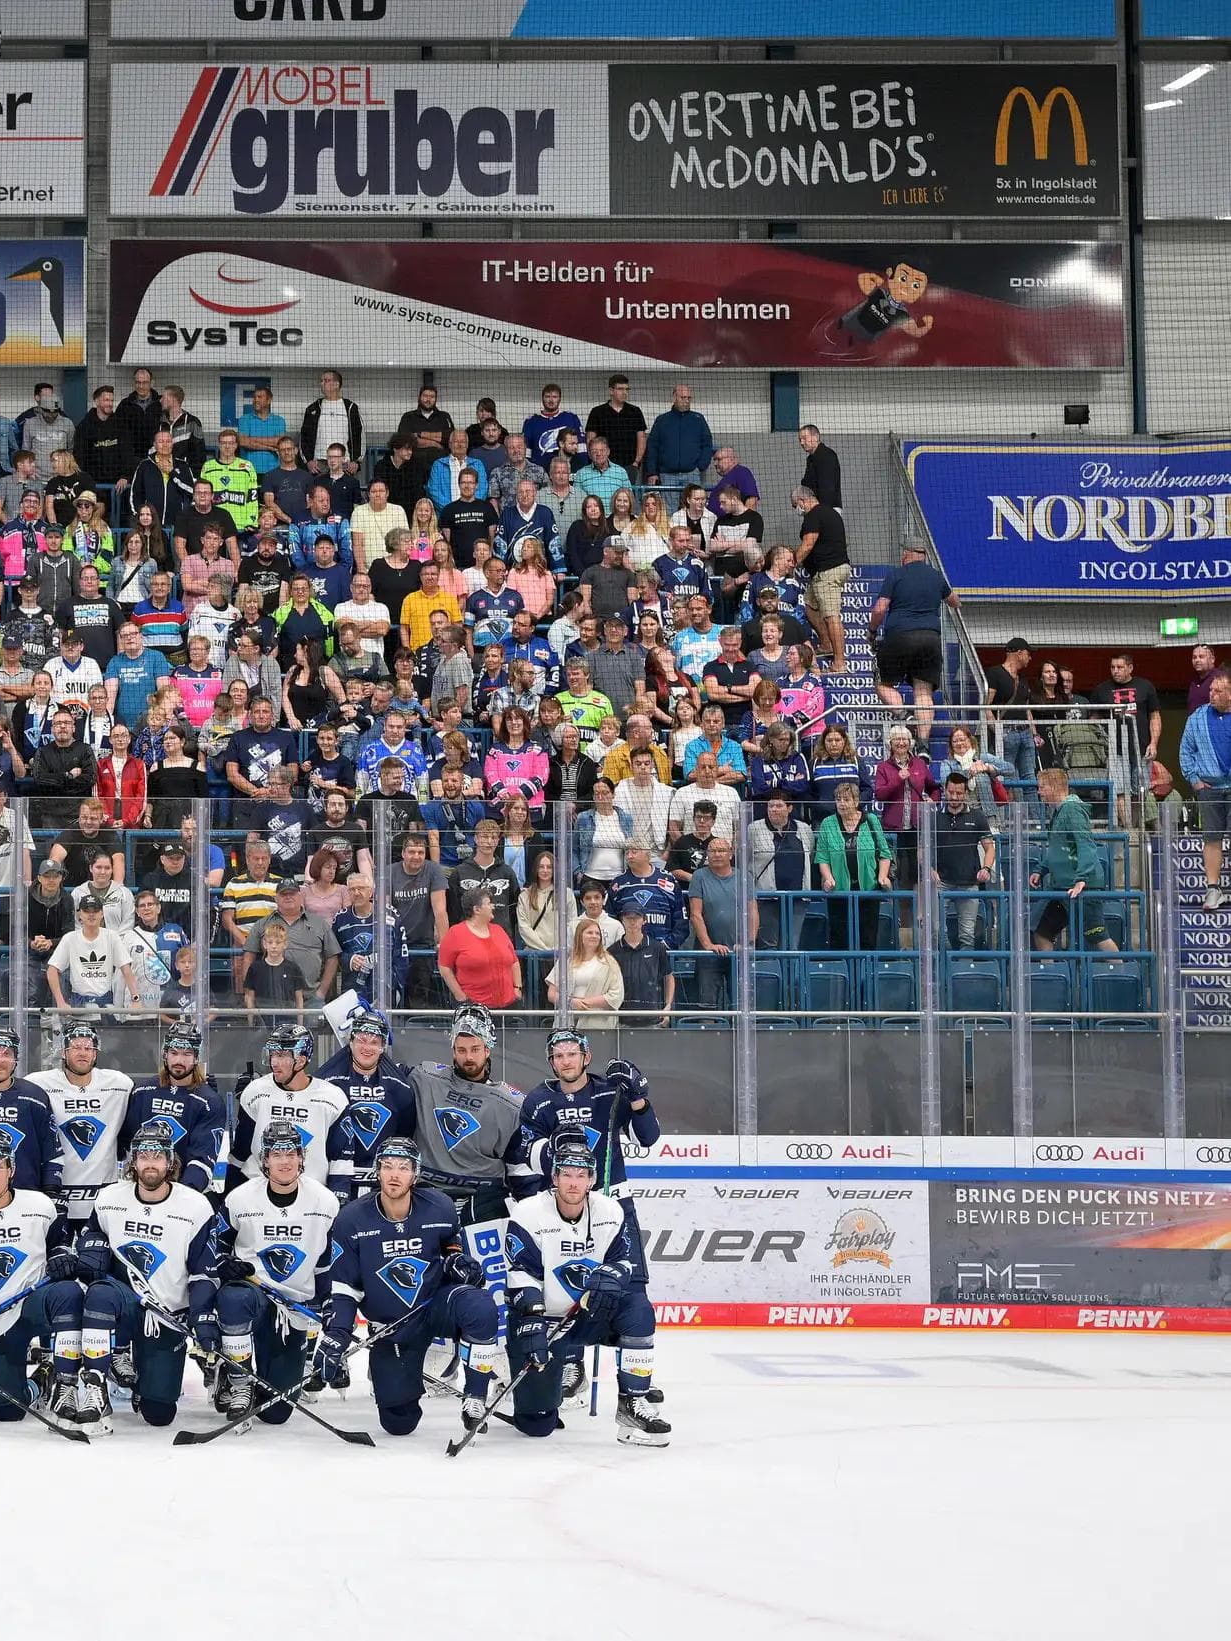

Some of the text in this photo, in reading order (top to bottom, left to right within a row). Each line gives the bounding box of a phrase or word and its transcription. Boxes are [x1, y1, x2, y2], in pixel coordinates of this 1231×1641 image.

[239, 66, 386, 106] MÖBEL
[230, 89, 555, 215] gruber
[996, 177, 1098, 193] 5x in Ingolstadt
[882, 186, 899, 205] ICH
[902, 185, 930, 204] LIEBE
[996, 193, 1096, 205] www.mcdonalds.de
[295, 201, 555, 212] Siemensstr. 7 Gaimersheim
[481, 259, 654, 284] IT-Helden für
[605, 297, 791, 321] Unternehmen
[353, 293, 563, 356] www.systec-computer.de
[146, 319, 305, 352] SysTec
[72, 603, 110, 611] PANTHER
[73, 616, 110, 625] HOCKEY
[394, 887, 428, 898] HOLLISTER
[80, 970, 107, 978] adidas
[349, 1085, 386, 1097] ERC
[64, 1098, 101, 1109] ERC
[151, 1098, 185, 1113] ERC
[270, 1105, 309, 1119] ERC
[557, 1106, 593, 1120] ERC
[659, 1143, 709, 1158] Audi
[841, 1144, 892, 1159] Audi
[1092, 1146, 1145, 1161] Audi
[956, 1188, 1016, 1203] BRING
[1021, 1188, 1062, 1204] DEN
[1067, 1189, 1120, 1205] PUCK
[1126, 1190, 1159, 1205] INS
[1164, 1190, 1216, 1206] NETZ
[956, 1209, 1155, 1226] BEWIRB DICH JETZT!
[124, 1220, 164, 1236] ERC
[263, 1224, 303, 1237] ERC
[381, 1237, 423, 1253] ERC
[824, 1228, 897, 1251] Fairplay
[810, 1272, 912, 1284] IHR FACHHÄNDLER
[820, 1287, 902, 1297] IN INGOLSTADT
[957, 1292, 1110, 1302] FUTURE MOBILITY SOLUTIONS
